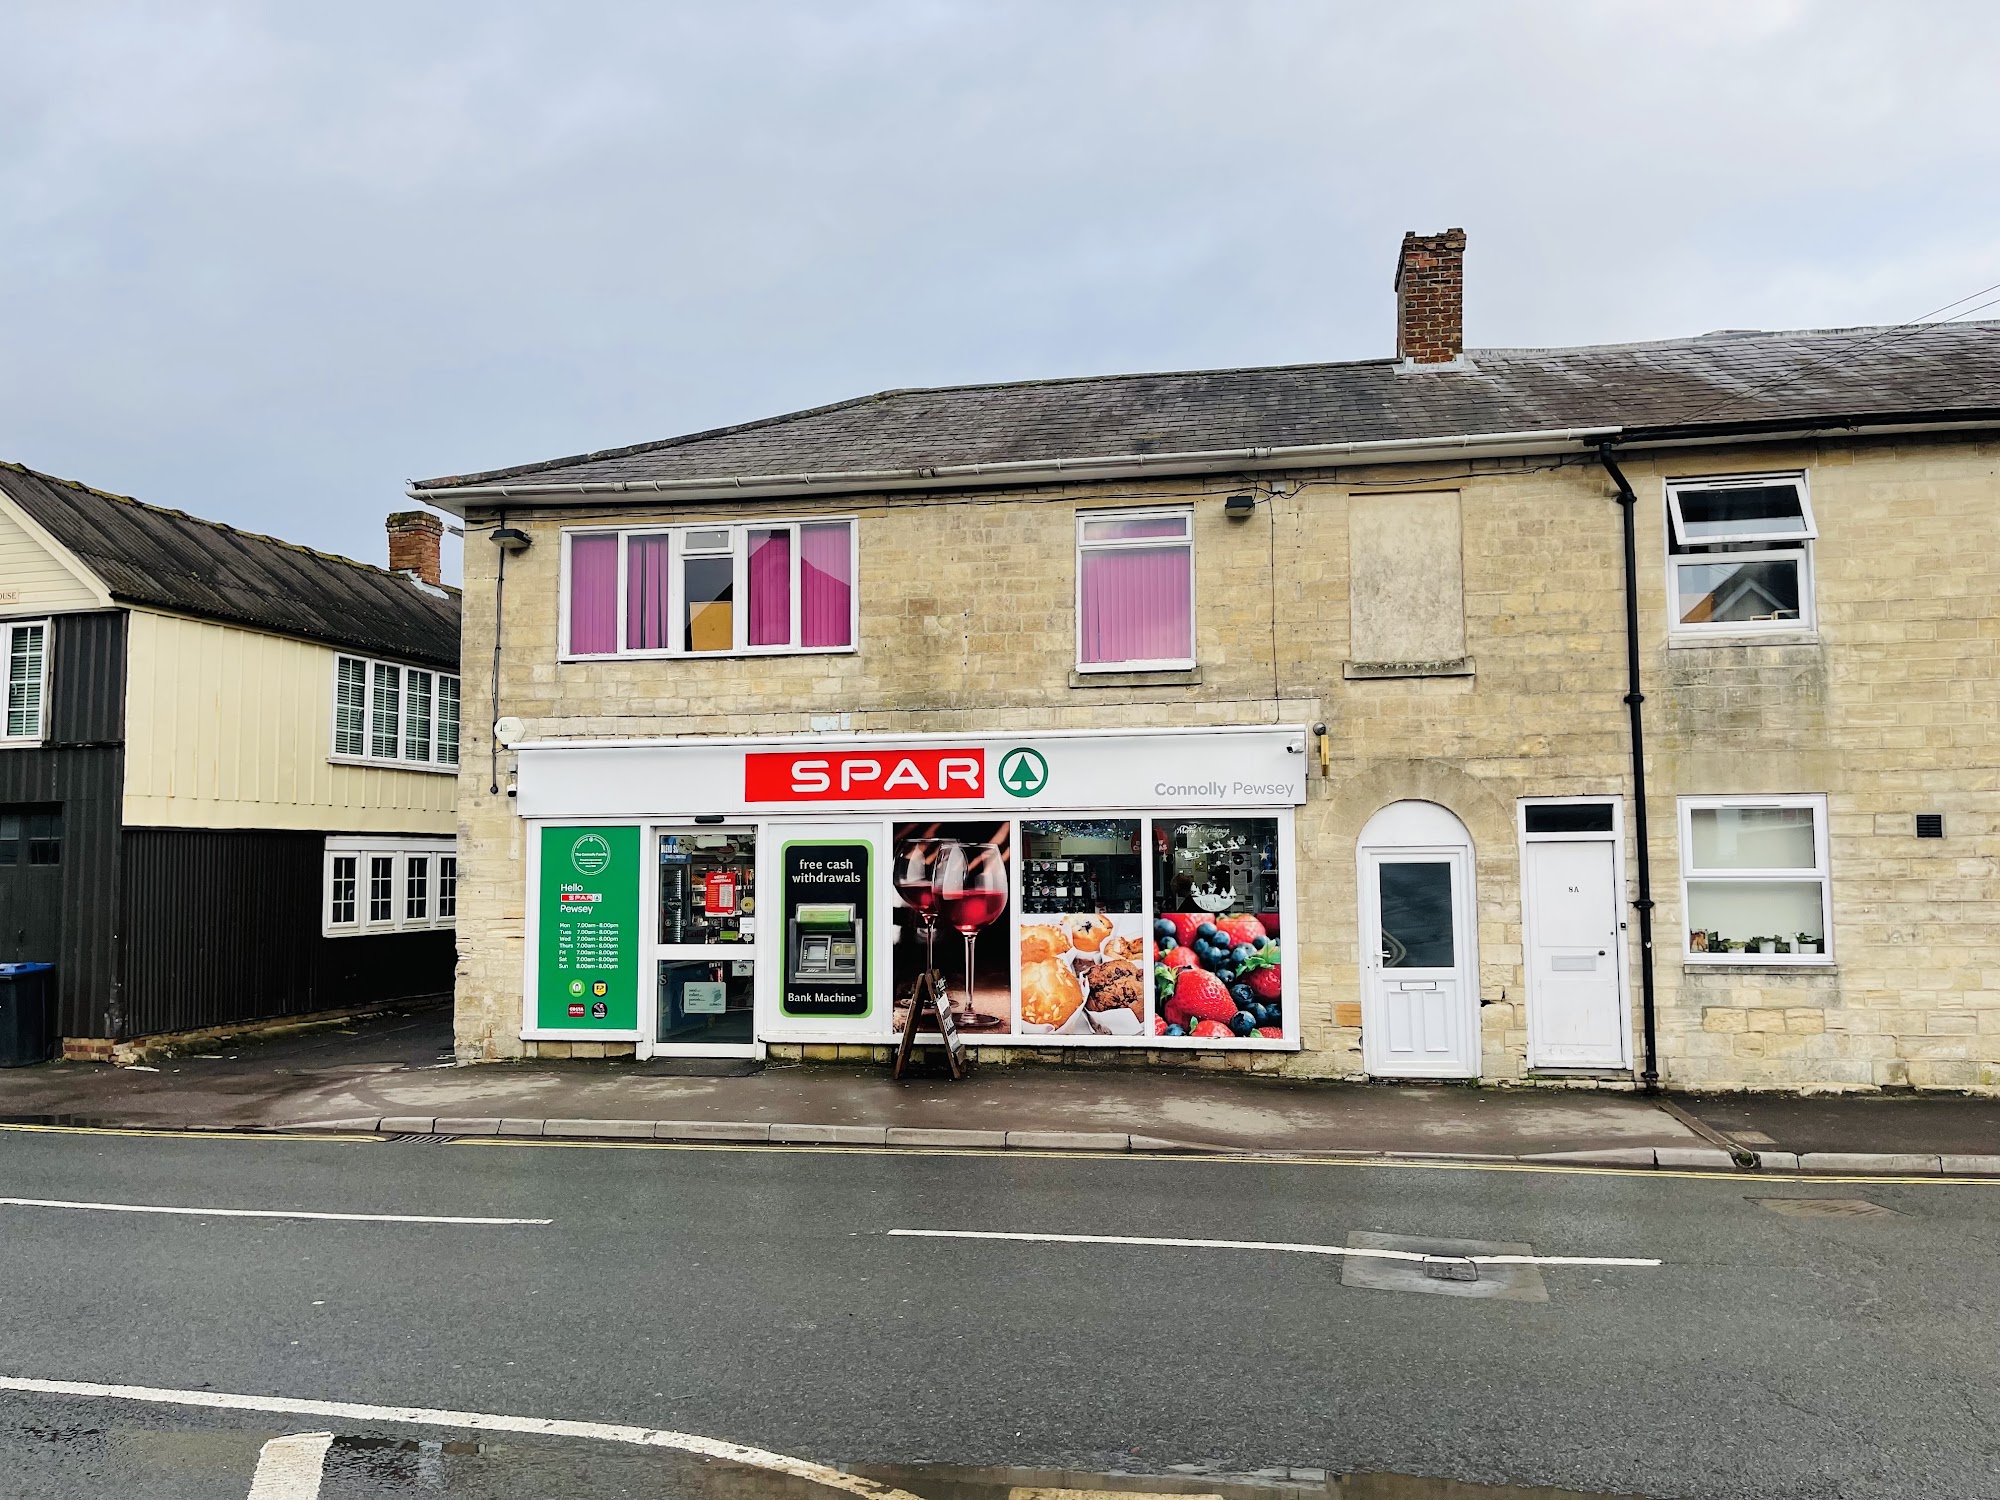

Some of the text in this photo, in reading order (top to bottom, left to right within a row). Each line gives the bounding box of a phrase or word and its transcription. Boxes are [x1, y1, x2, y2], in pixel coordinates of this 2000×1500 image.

[791, 758, 980, 793] SPAR
[1154, 781, 1294, 798] Connolly Pewsey
[799, 859, 853, 869] free cash
[792, 872, 861, 883] withdrawals
[560, 883, 584, 891] Hello
[560, 904, 594, 915] Pewsey
[788, 992, 856, 1002] Bank Machine
